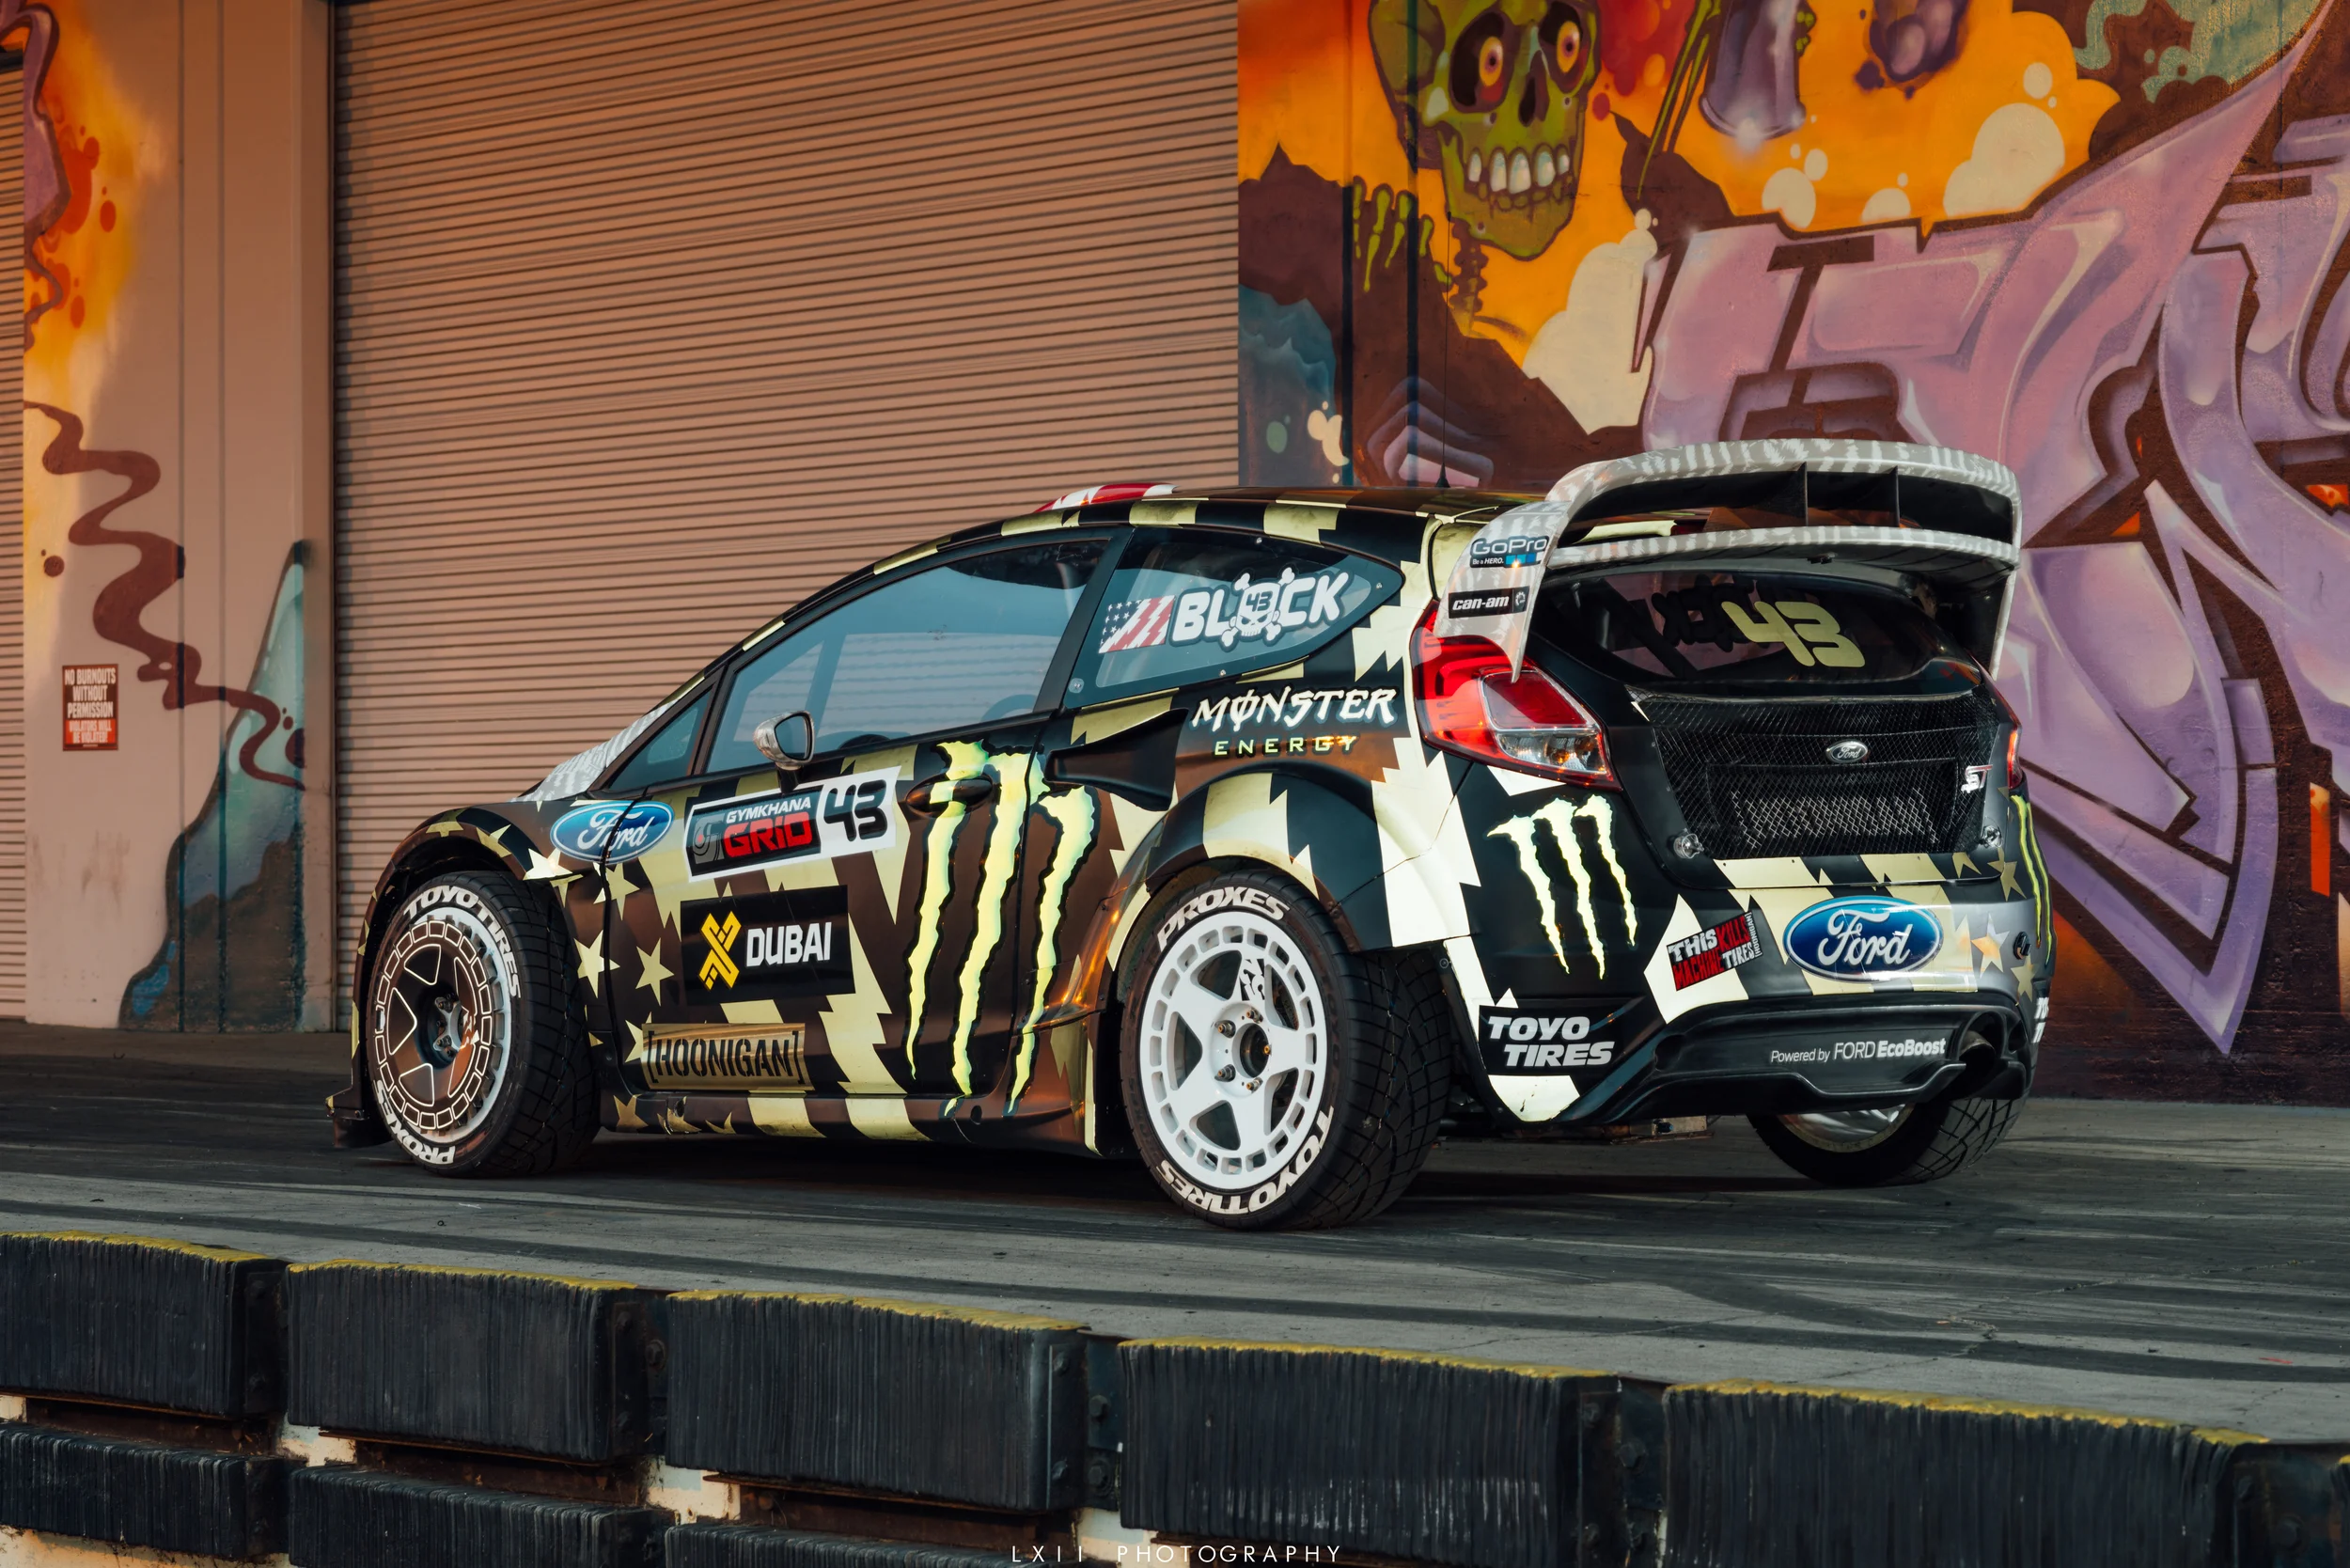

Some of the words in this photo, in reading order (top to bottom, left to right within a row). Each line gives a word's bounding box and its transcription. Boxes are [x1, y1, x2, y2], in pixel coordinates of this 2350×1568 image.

[1472, 539, 1547, 555] GoPro
[1246, 590, 1274, 611] 43
[1452, 596, 1510, 611] can-am
[1721, 602, 1866, 667] 43
[65, 668, 75, 685] NO
[76, 667, 117, 685] BURNOUTS
[72, 684, 108, 701] WITHOUT
[67, 701, 114, 718] PERMISSION
[1214, 735, 1356, 756] ENERGY
[1838, 745, 1861, 759] Ford
[726, 796, 811, 823] GYMKHANA
[823, 779, 888, 842] 43
[577, 806, 650, 851] Ford
[1157, 886, 1290, 952] PROXES
[403, 886, 478, 920] TOYO
[477, 906, 522, 998] TIRES
[746, 922, 832, 967] DUBAI
[1668, 928, 1718, 962] THIS
[1715, 915, 1750, 952] KILLS
[1818, 909, 1914, 966] Ford
[1673, 947, 1725, 990] MACHINE
[1722, 941, 1755, 969] TIRES
[1488, 1016, 1590, 1042] TOYO
[1504, 1042, 1616, 1067] TIRES
[1770, 1048, 1817, 1062] Powered
[1818, 1047, 1831, 1063] by
[1834, 1041, 1876, 1060] FORD
[1877, 1037, 1947, 1058] EcoBoost
[373, 1079, 456, 1165] PROXES
[1246, 1105, 1334, 1214] TOYO
[1156, 1159, 1250, 1215] TIRES
